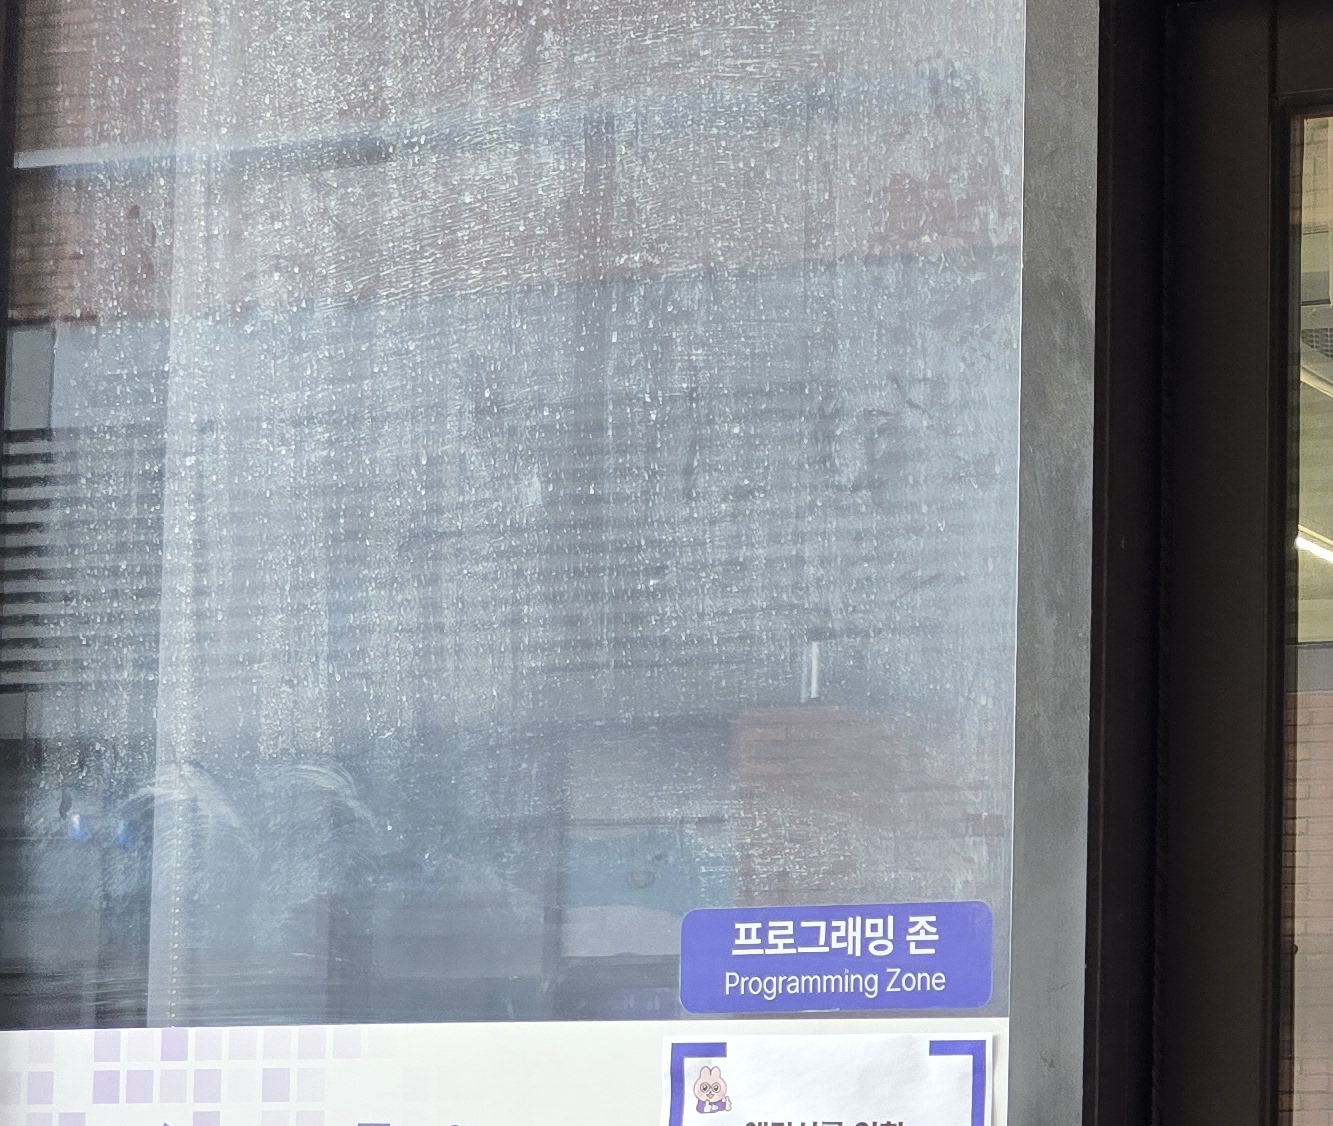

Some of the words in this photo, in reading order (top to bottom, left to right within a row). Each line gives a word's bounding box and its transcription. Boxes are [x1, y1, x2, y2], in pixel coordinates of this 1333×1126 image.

[732, 916, 893, 956] 프로그래밍
[906, 916, 939, 954] 존
[726, 969, 878, 1000] Programming
[887, 969, 945, 991] Zone
